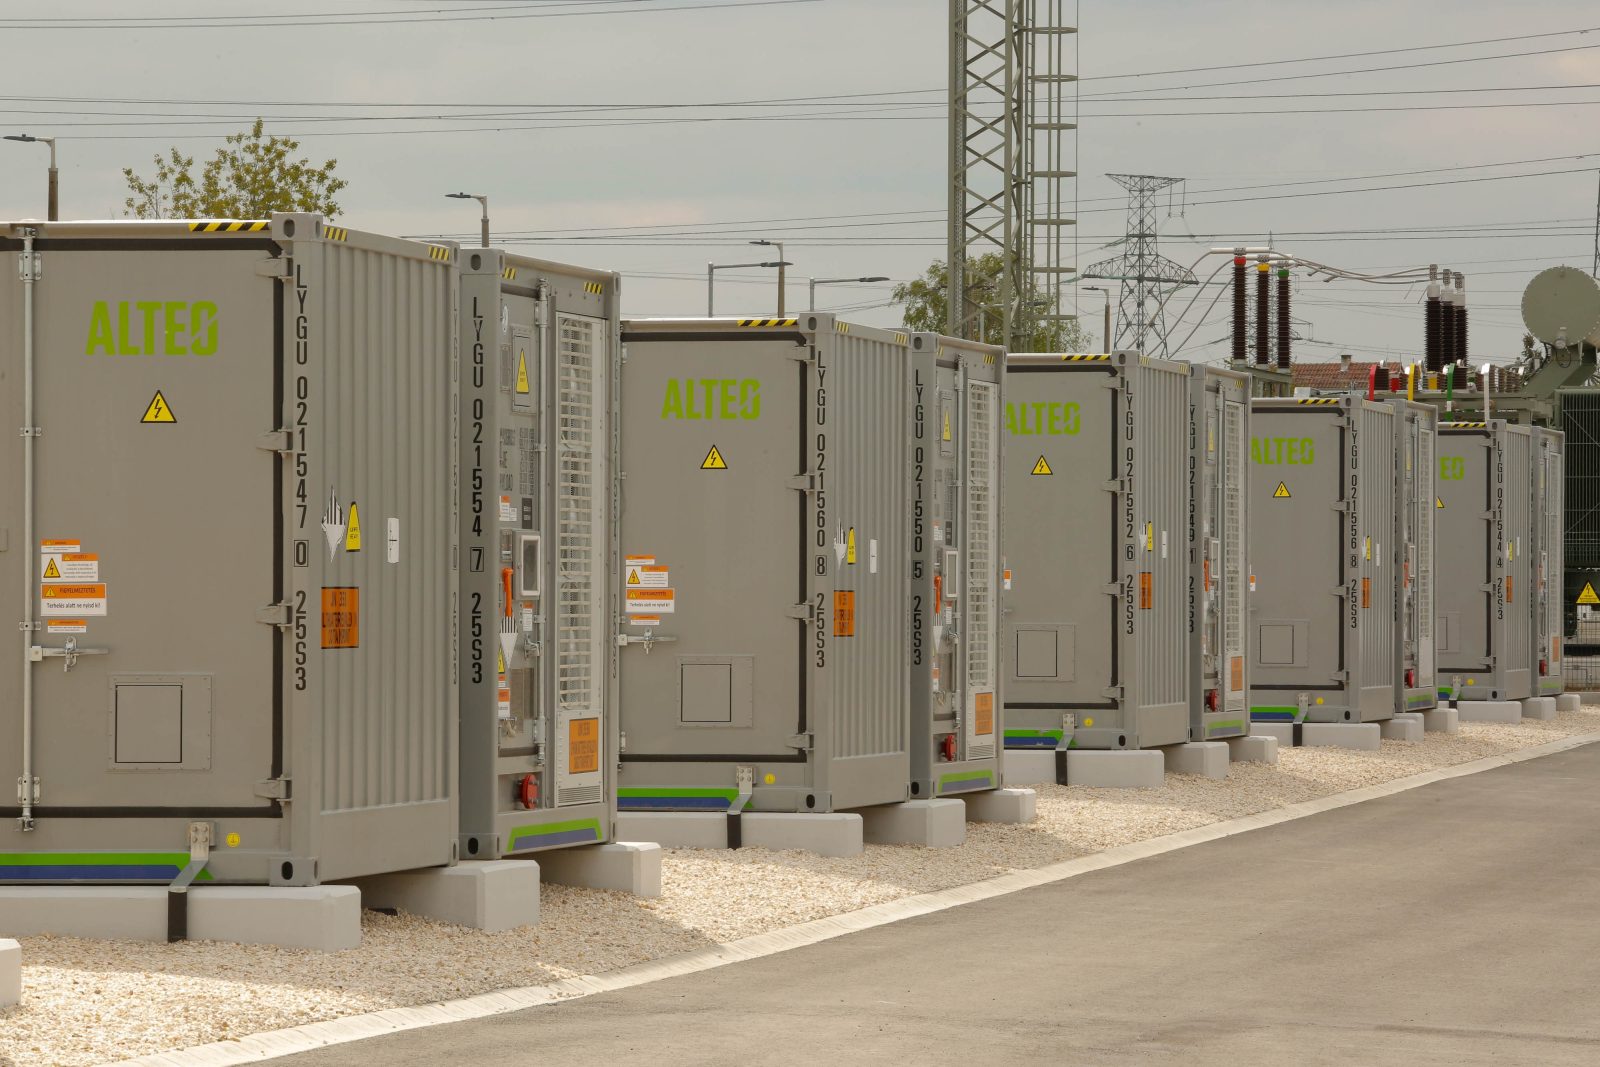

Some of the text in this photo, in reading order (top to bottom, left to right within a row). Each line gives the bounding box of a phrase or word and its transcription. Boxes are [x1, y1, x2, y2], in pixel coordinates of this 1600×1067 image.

[84, 300, 219, 357] ALTEO
[296, 264, 308, 366] LYGU
[660, 377, 762, 421] ALTEO
[1005, 401, 1081, 436] ALTEO
[1126, 380, 1134, 441] LYGU
[296, 375, 308, 529] 021547
[471, 296, 484, 684] LYGU 021554 7 25S3
[1126, 446, 1134, 539] 021552
[1250, 436, 1315, 465] ALTEO
[816, 351, 826, 668] LYGU 021560 8 25S3
[913, 369, 924, 666] LYGU 021550 5 25S3
[295, 590, 307, 691] 25S3
[1126, 574, 1134, 635] 25S3
